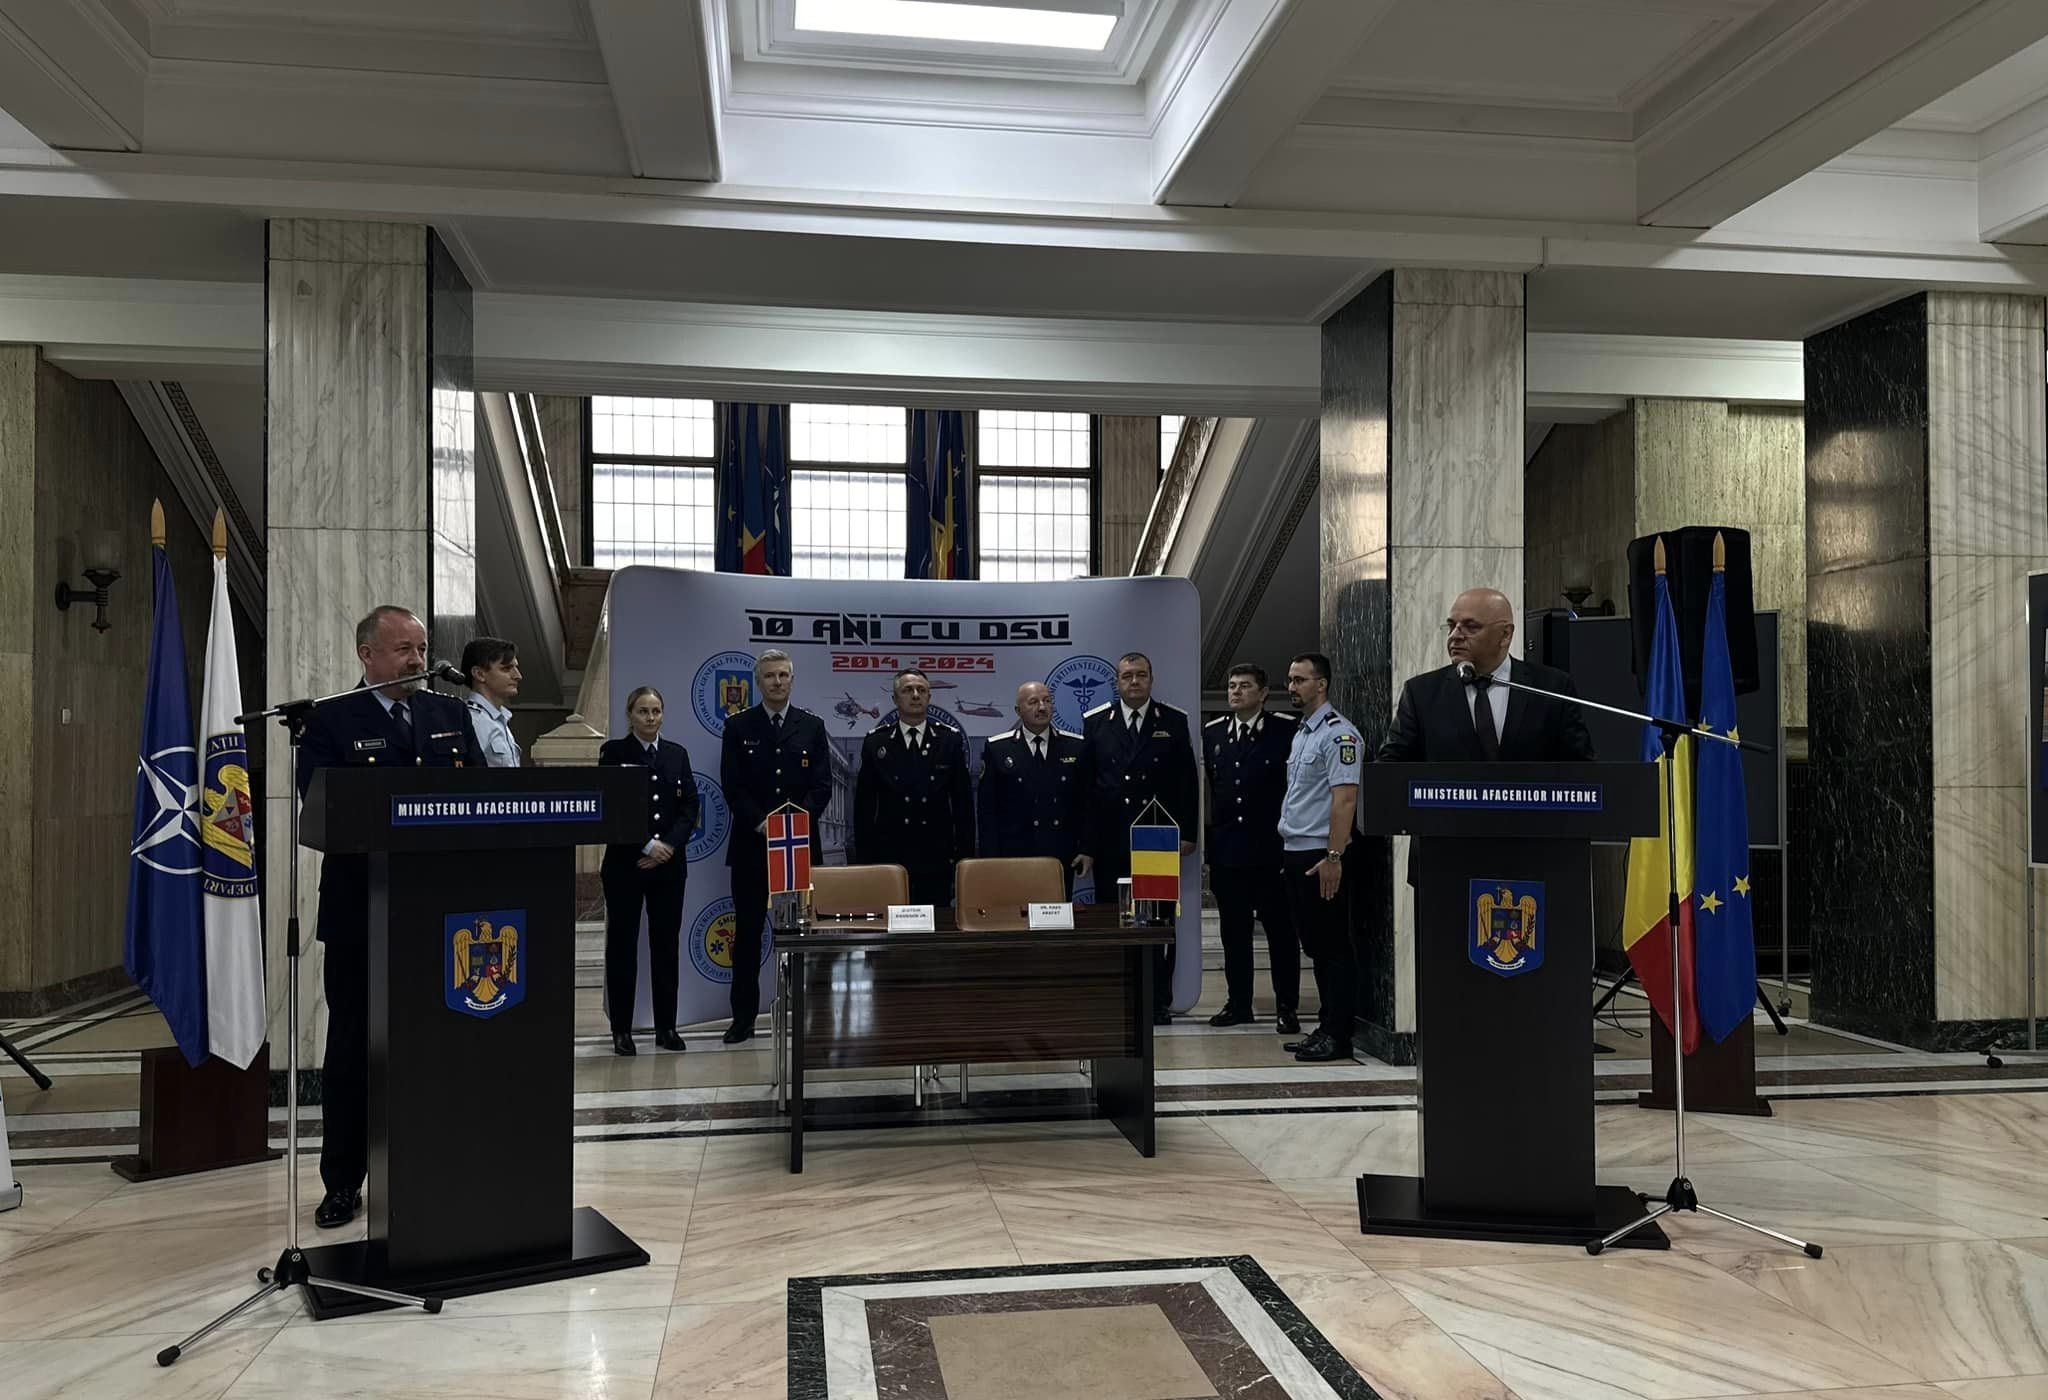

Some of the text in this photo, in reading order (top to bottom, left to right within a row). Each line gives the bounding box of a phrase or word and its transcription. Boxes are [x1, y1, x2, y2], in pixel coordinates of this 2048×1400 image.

[748, 616, 793, 636] 10
[901, 621, 960, 640] CU
[980, 621, 1069, 640] DSU
[832, 656, 899, 669] 2014
[1413, 787, 1598, 803] MINISTERUL AFACERILOR INTERNE
[398, 799, 597, 817] MINISTERUL AFACERILOR INTERNE
